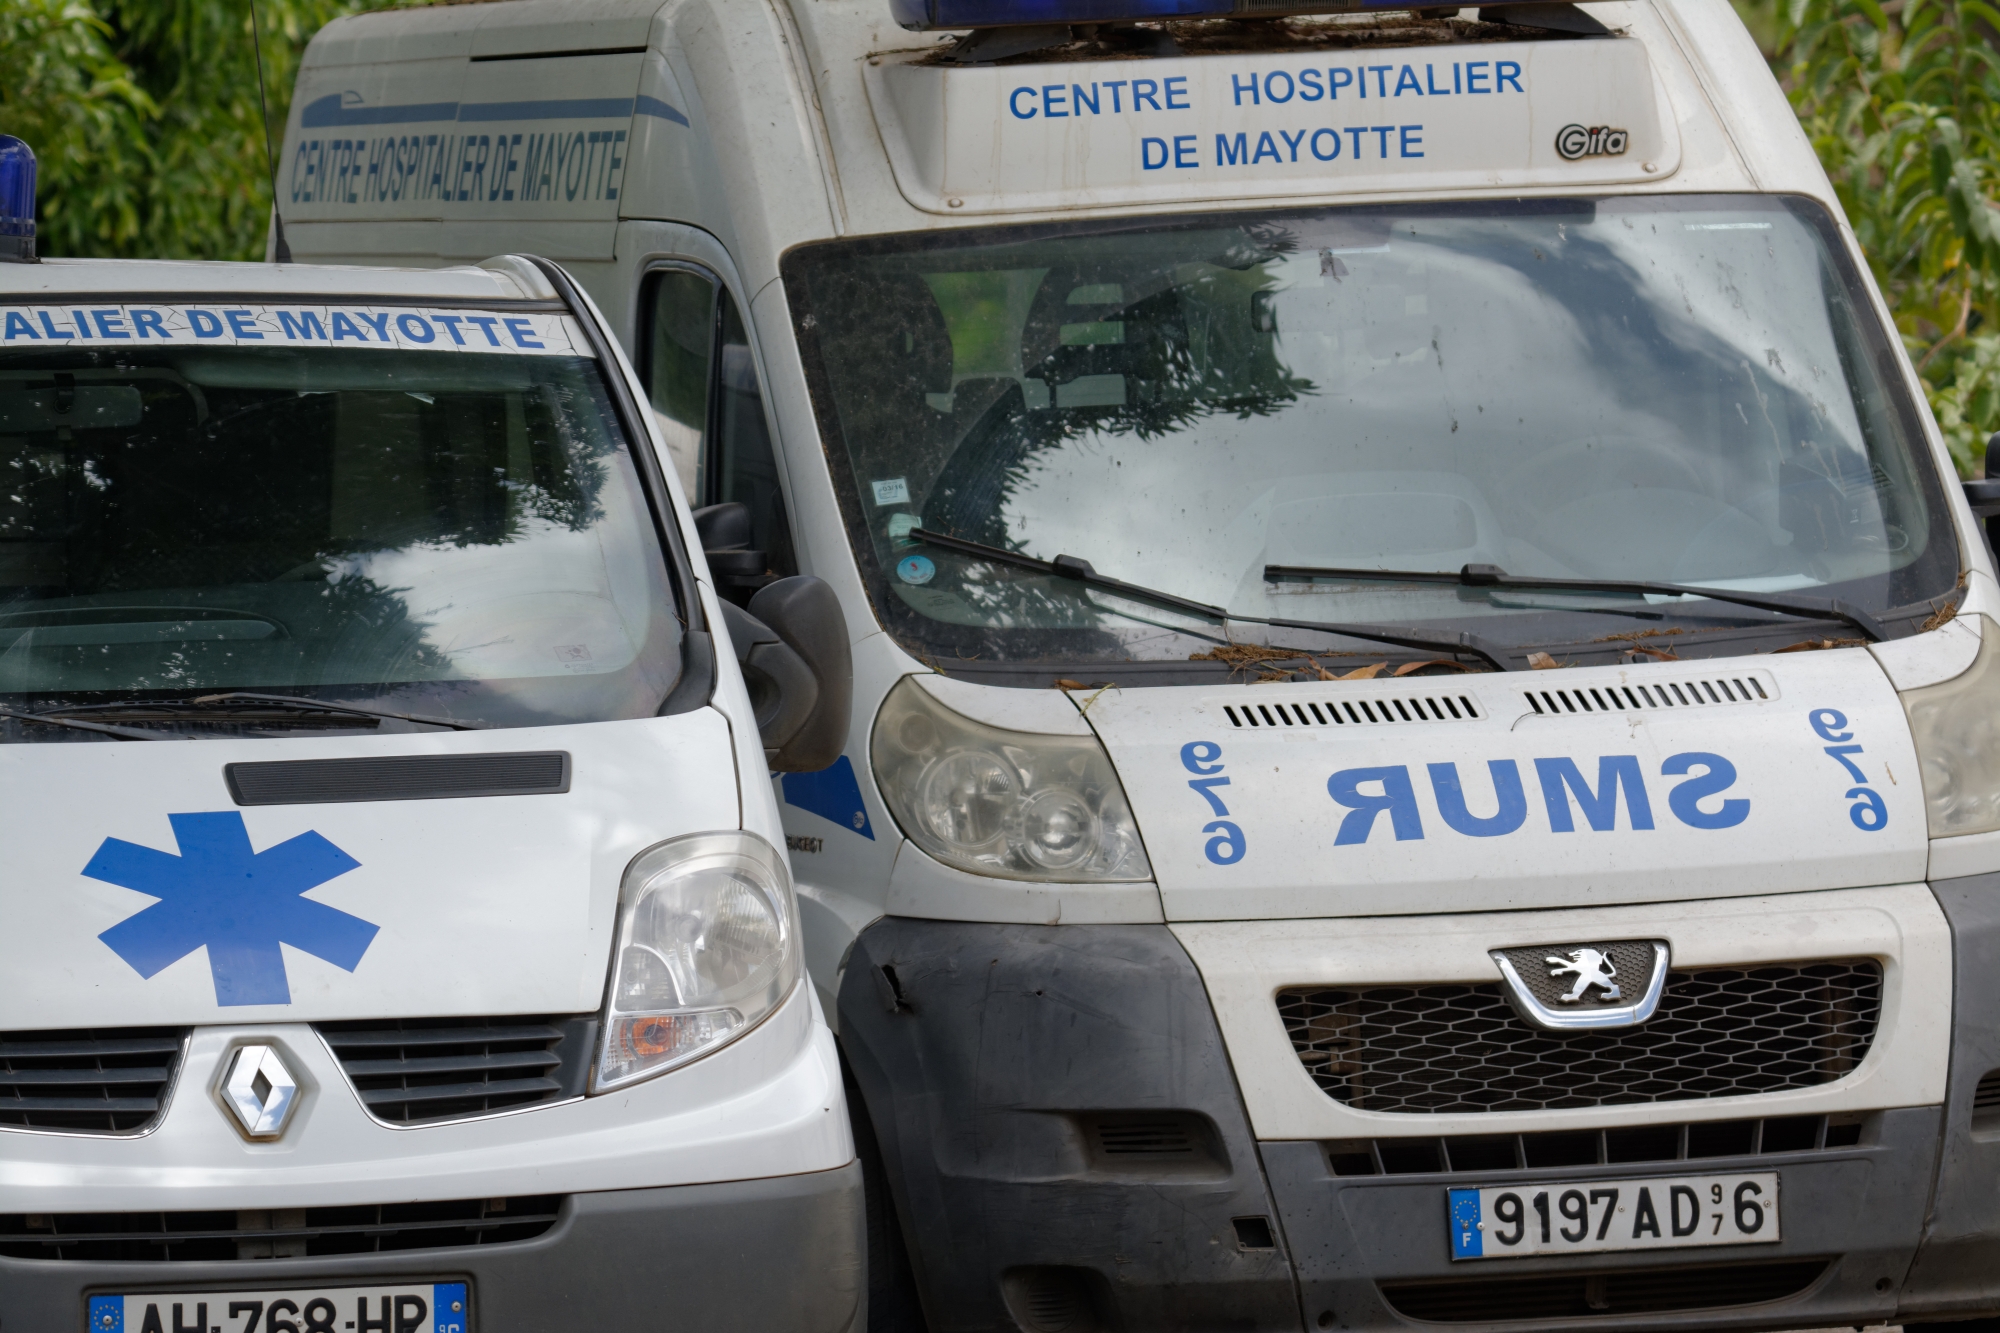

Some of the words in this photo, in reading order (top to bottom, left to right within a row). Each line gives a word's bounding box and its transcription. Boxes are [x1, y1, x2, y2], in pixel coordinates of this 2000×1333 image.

[1010, 77, 1190, 119] CENTRE
[1232, 62, 1523, 105] HOSPITALIER
[1142, 136, 1198, 170] DE
[1216, 126, 1424, 166] MAYOTTE
[1556, 124, 1627, 160] Gifa
[291, 139, 366, 203] CENTRE
[363, 133, 490, 203] HOSPITALIER
[489, 134, 523, 201] DE
[520, 130, 627, 202] MAYOTTE
[5, 310, 173, 339] ALIER
[185, 310, 264, 339] DE
[275, 311, 546, 349] MAYOTTE
[784, 834, 824, 853] EUGEOT
[1462, 1232, 1472, 1248] F
